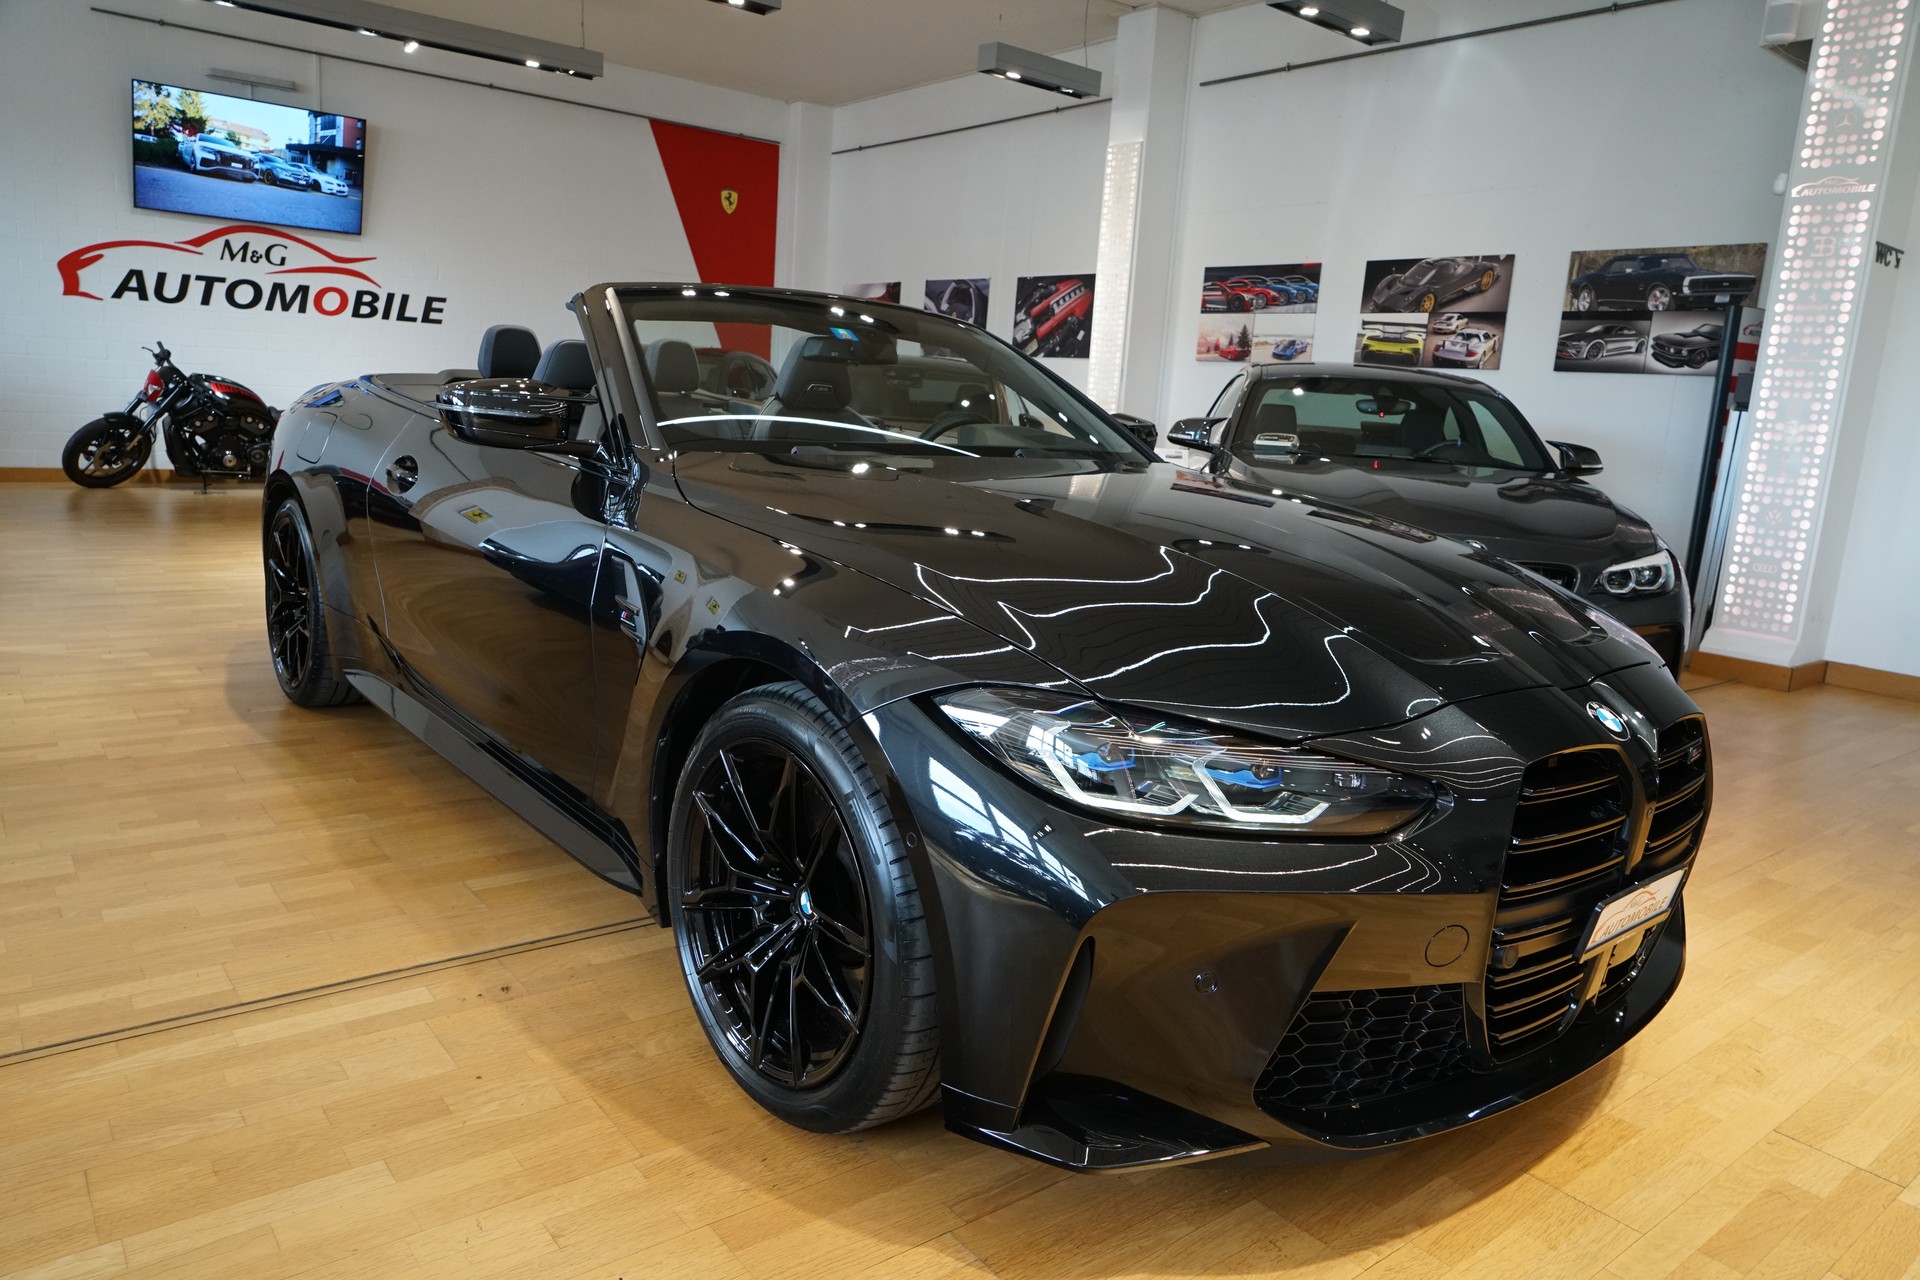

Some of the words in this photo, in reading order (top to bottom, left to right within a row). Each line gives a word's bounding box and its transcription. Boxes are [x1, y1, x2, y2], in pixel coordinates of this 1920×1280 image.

[1800, 184, 1877, 197] AUTOMOBILE
[220, 239, 288, 266] M&G
[111, 269, 447, 324] AUTOMOBILE
[1599, 896, 1669, 940] AUTOMOBILE
